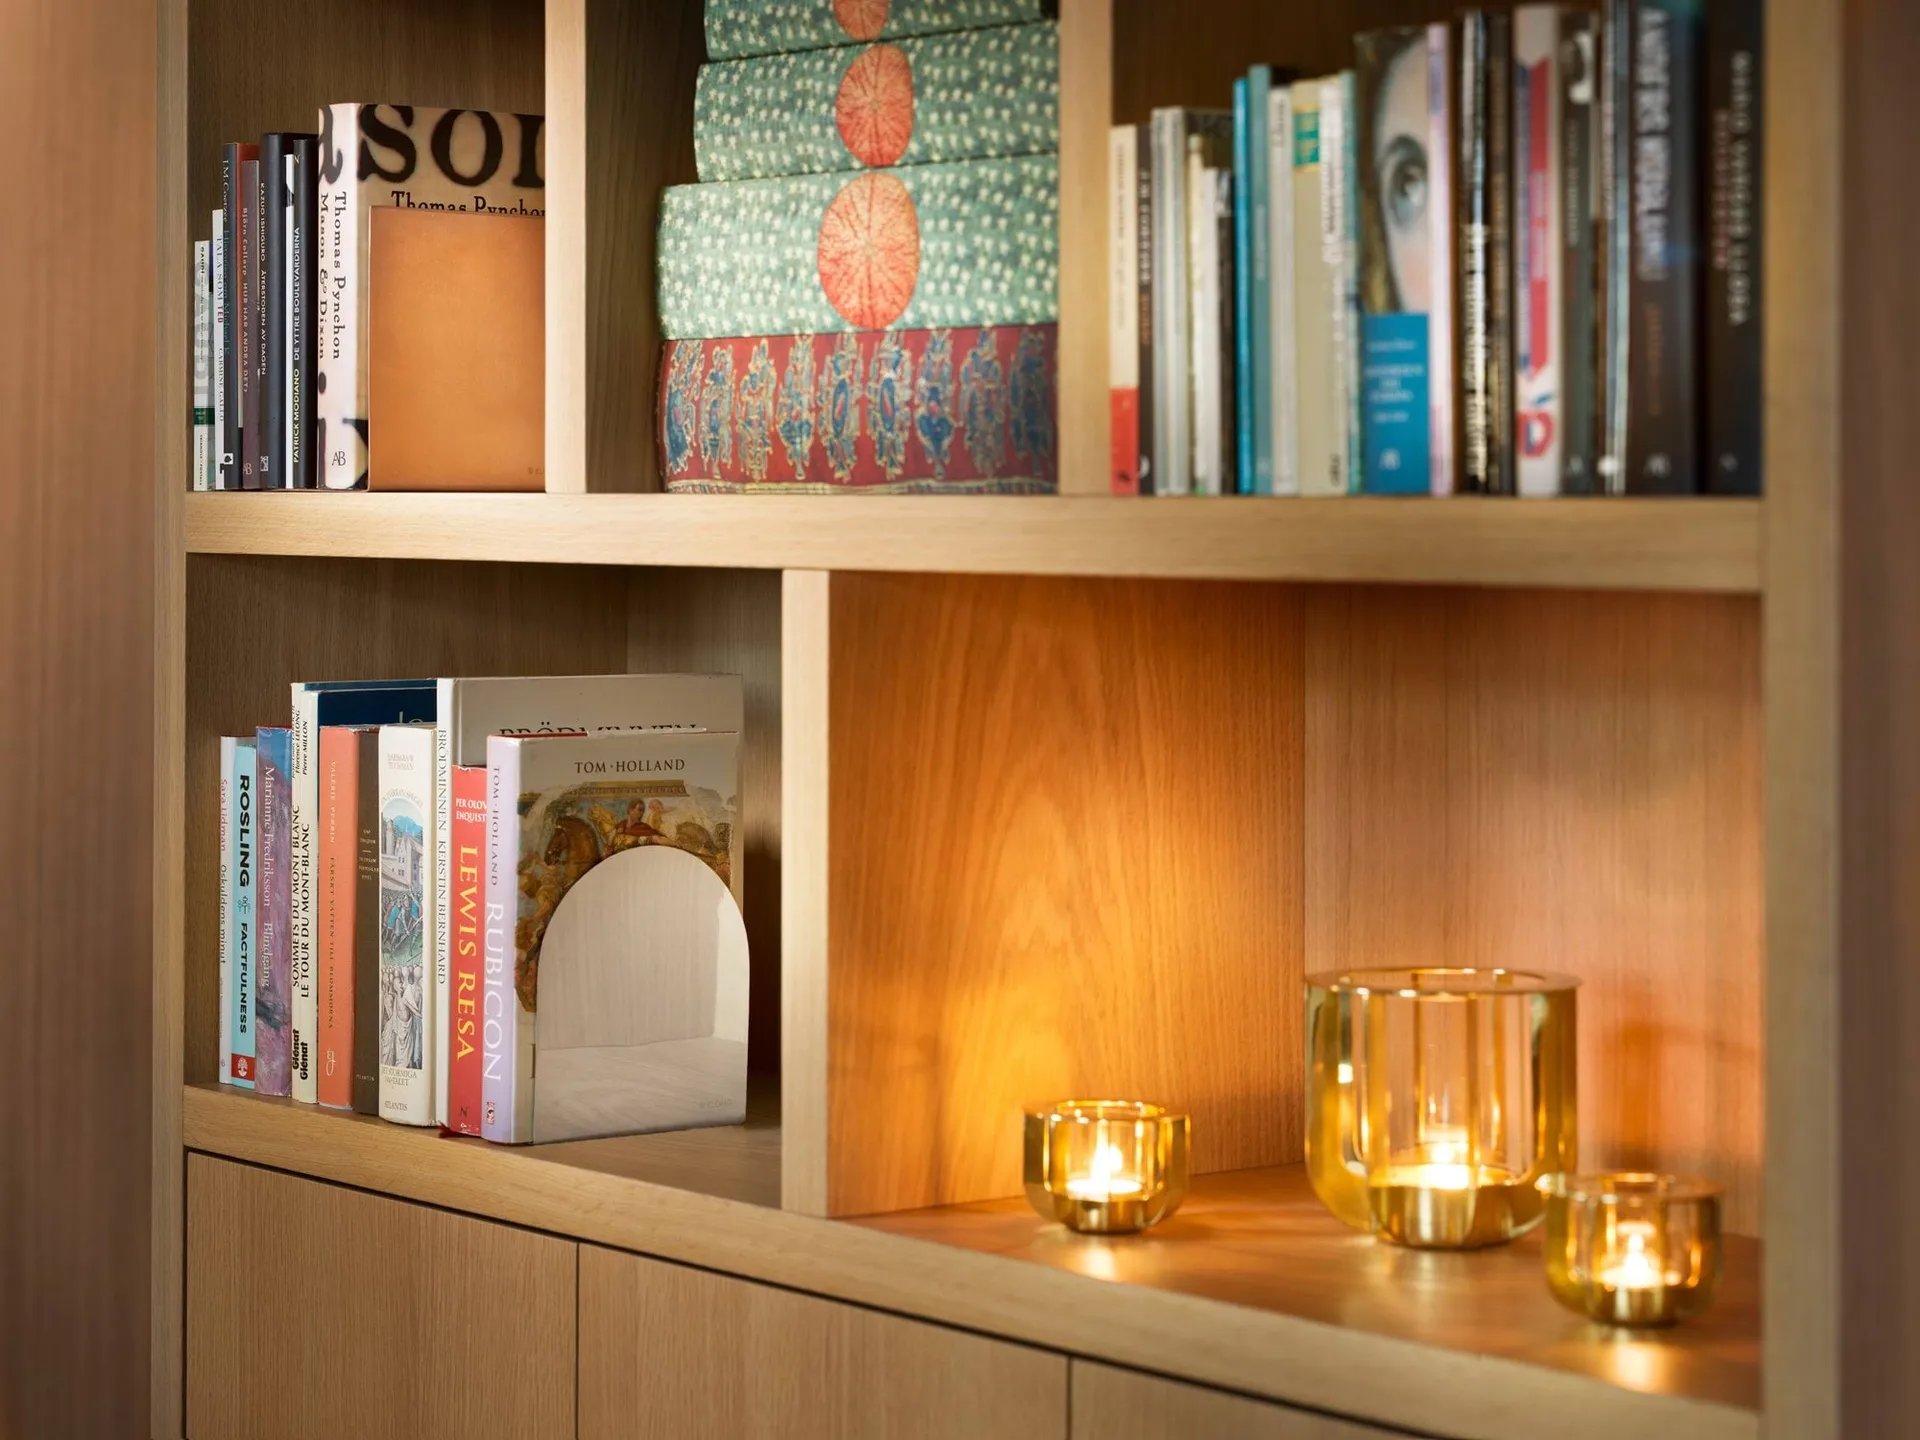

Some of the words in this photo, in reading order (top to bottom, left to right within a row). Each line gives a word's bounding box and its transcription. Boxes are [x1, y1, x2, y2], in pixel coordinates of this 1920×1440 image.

[320, 192, 328, 259] Mason
[334, 191, 346, 268] Thomas
[320, 268, 328, 294] &
[260, 329, 266, 341] AV
[320, 299, 328, 360] Dixon
[332, 276, 346, 360] Pynchon
[293, 348, 299, 361] DE
[220, 779, 228, 803] Sara
[492, 766, 500, 799] TOM
[574, 762, 606, 774] TOM
[616, 758, 685, 773] HOLLAND
[263, 766, 275, 829] Marianne
[456, 798, 467, 808] PER
[467, 799, 487, 810] OLOV
[456, 811, 487, 823] ENQUIST
[240, 775, 250, 887] ROSLING
[491, 805, 499, 886] HOLLAND
[220, 864, 228, 925] Oskuldens
[263, 833, 274, 907] Fredriksson
[301, 823, 309, 913] MONT-BLANC
[438, 840, 446, 900] KERSTIN
[292, 899, 299, 920] DU
[301, 917, 309, 938] DU
[459, 844, 477, 957] LEWIS
[261, 922, 273, 988] Blindgång
[301, 943, 309, 981] TOUR
[438, 903, 446, 984] BERNHARD
[240, 922, 248, 1034] FACTFULNESS
[301, 985, 308, 999] LE
[483, 902, 504, 1082] RUBICON
[457, 970, 476, 1062] RESA
[300, 1042, 308, 1081] Glénat
